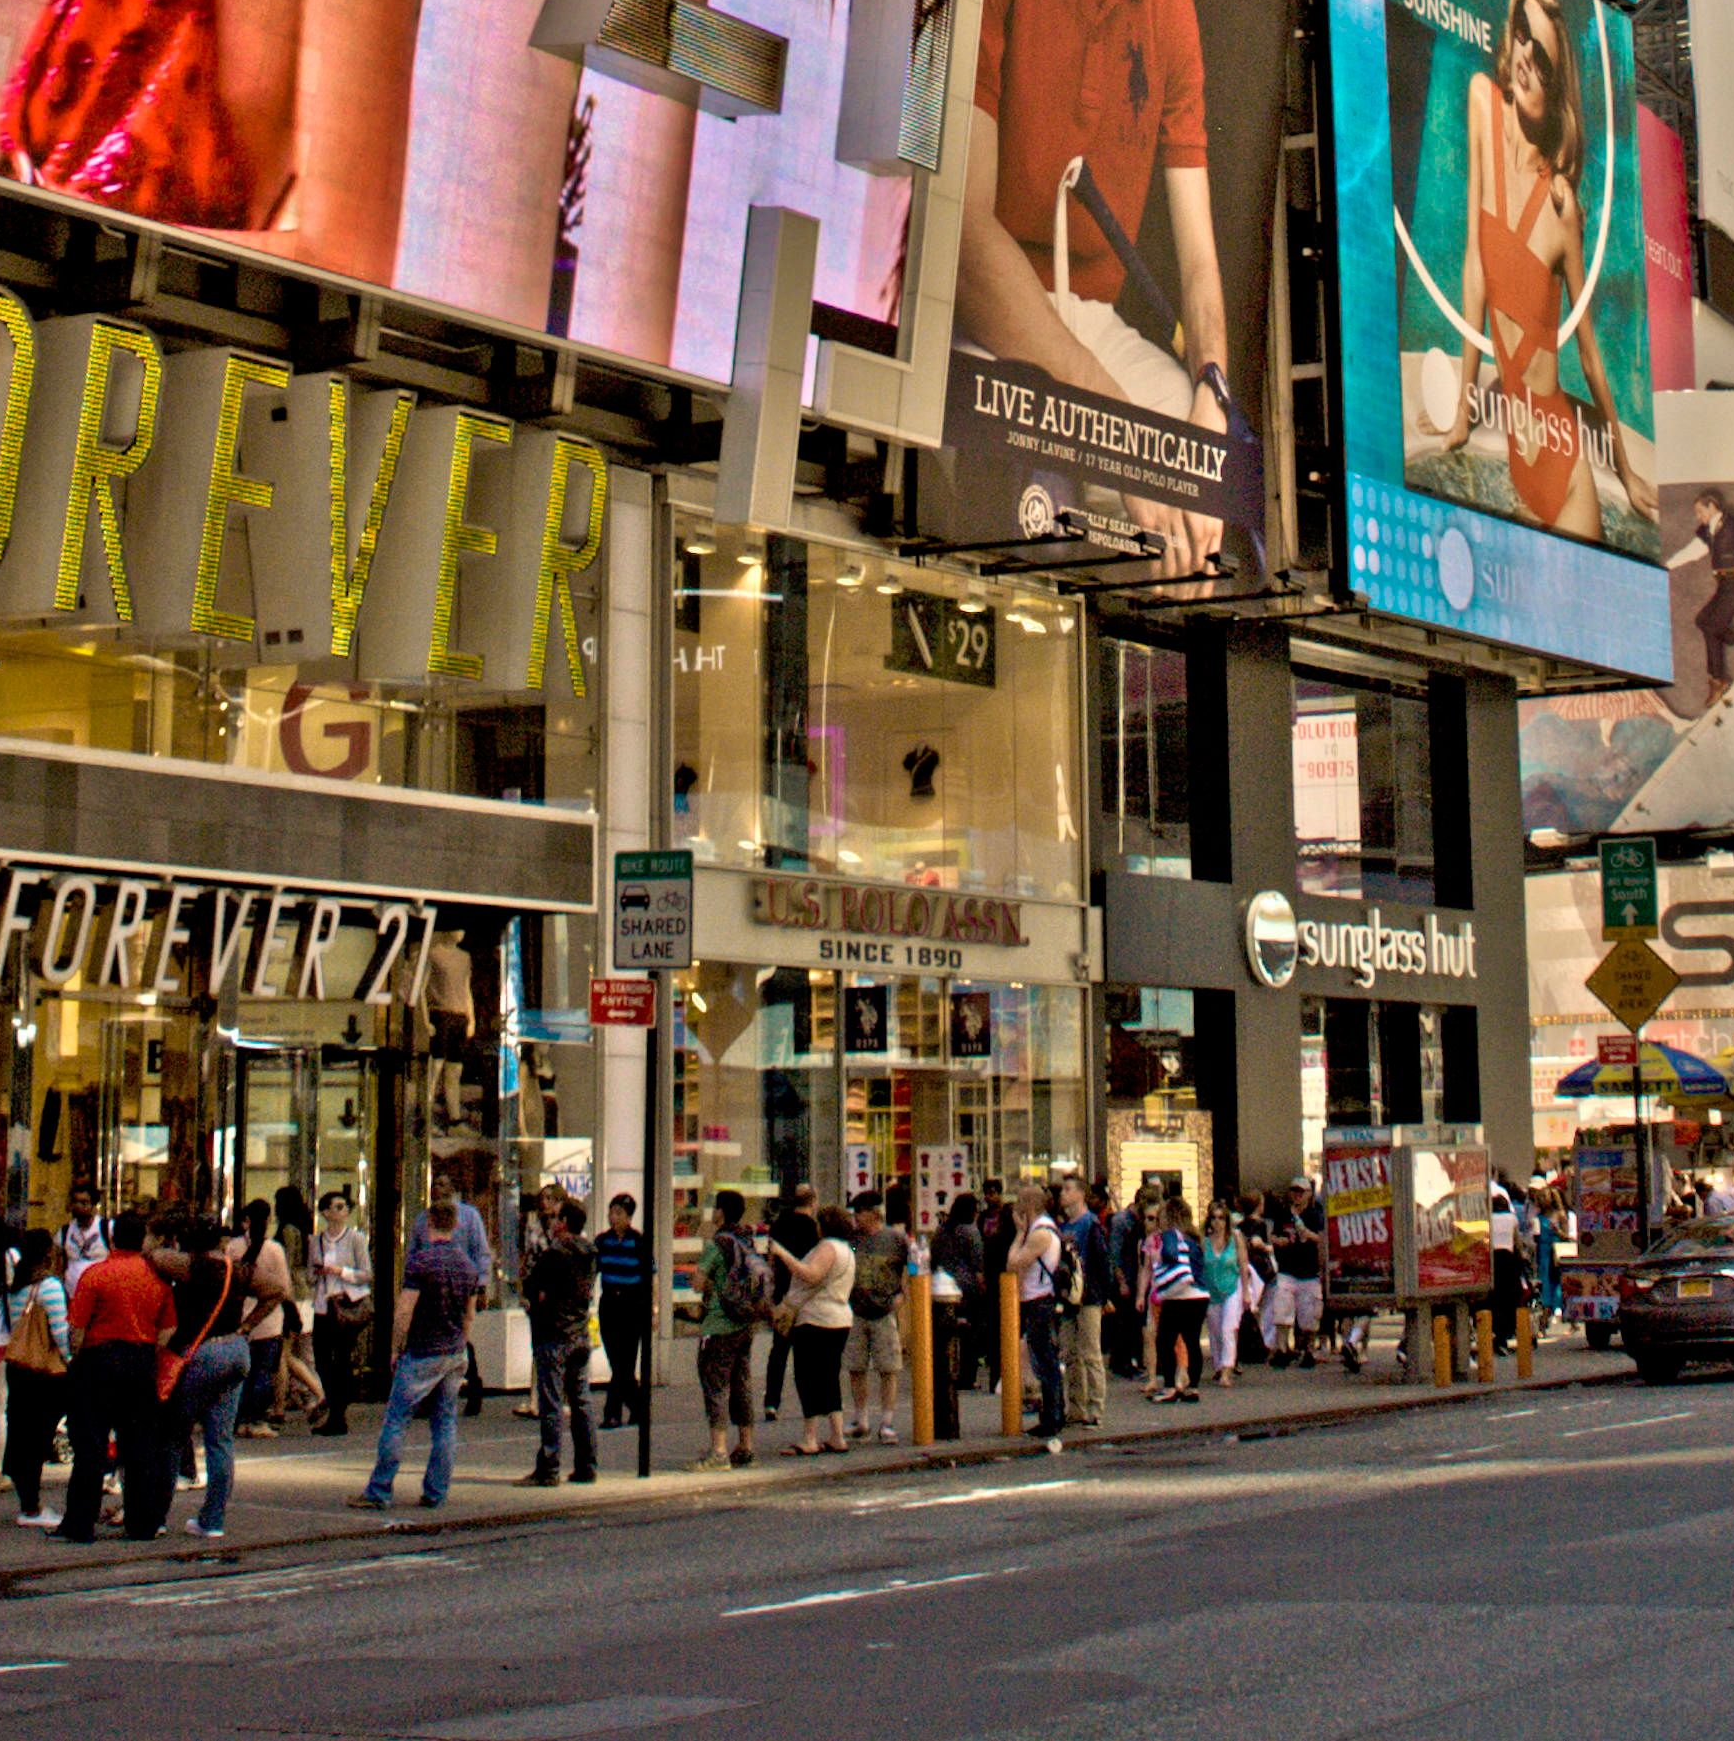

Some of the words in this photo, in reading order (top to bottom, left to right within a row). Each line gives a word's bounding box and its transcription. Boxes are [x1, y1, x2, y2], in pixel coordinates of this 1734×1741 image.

[974, 375, 1035, 426] LIVE
[1040, 396, 1227, 482] AUTHENTICALLY
[1466, 381, 1573, 457] sunglass
[1576, 405, 1618, 472] hut
[1007, 431, 1039, 453] JONNY
[1041, 439, 1076, 463] LAVINE
[1097, 458, 1122, 477] YEAR
[1123, 463, 1142, 481] OLD
[1142, 468, 1166, 489] POLO
[1167, 475, 1200, 498] PLAYER
[948, 620, 989, 670] $29
[278, 682, 372, 779] G
[620, 860, 645, 873] BIKE
[650, 859, 687, 873] ROUTE
[620, 918, 687, 936] SHARED
[765, 877, 829, 931] U.S.
[840, 886, 931, 937] POLO
[942, 897, 1031, 948] ASSN.
[362, 905, 438, 1005] 21
[631, 942, 675, 959] LANE
[819, 939, 894, 964] SINCE
[905, 946, 963, 970] 1890
[1298, 908, 1427, 989] sunglass
[1427, 913, 1478, 979] hut
[593, 982, 607, 993] NO
[600, 995, 645, 1007] ANYTIME
[1327, 1154, 1393, 1195] JERSEY
[1337, 1209, 1389, 1247] BOYS
